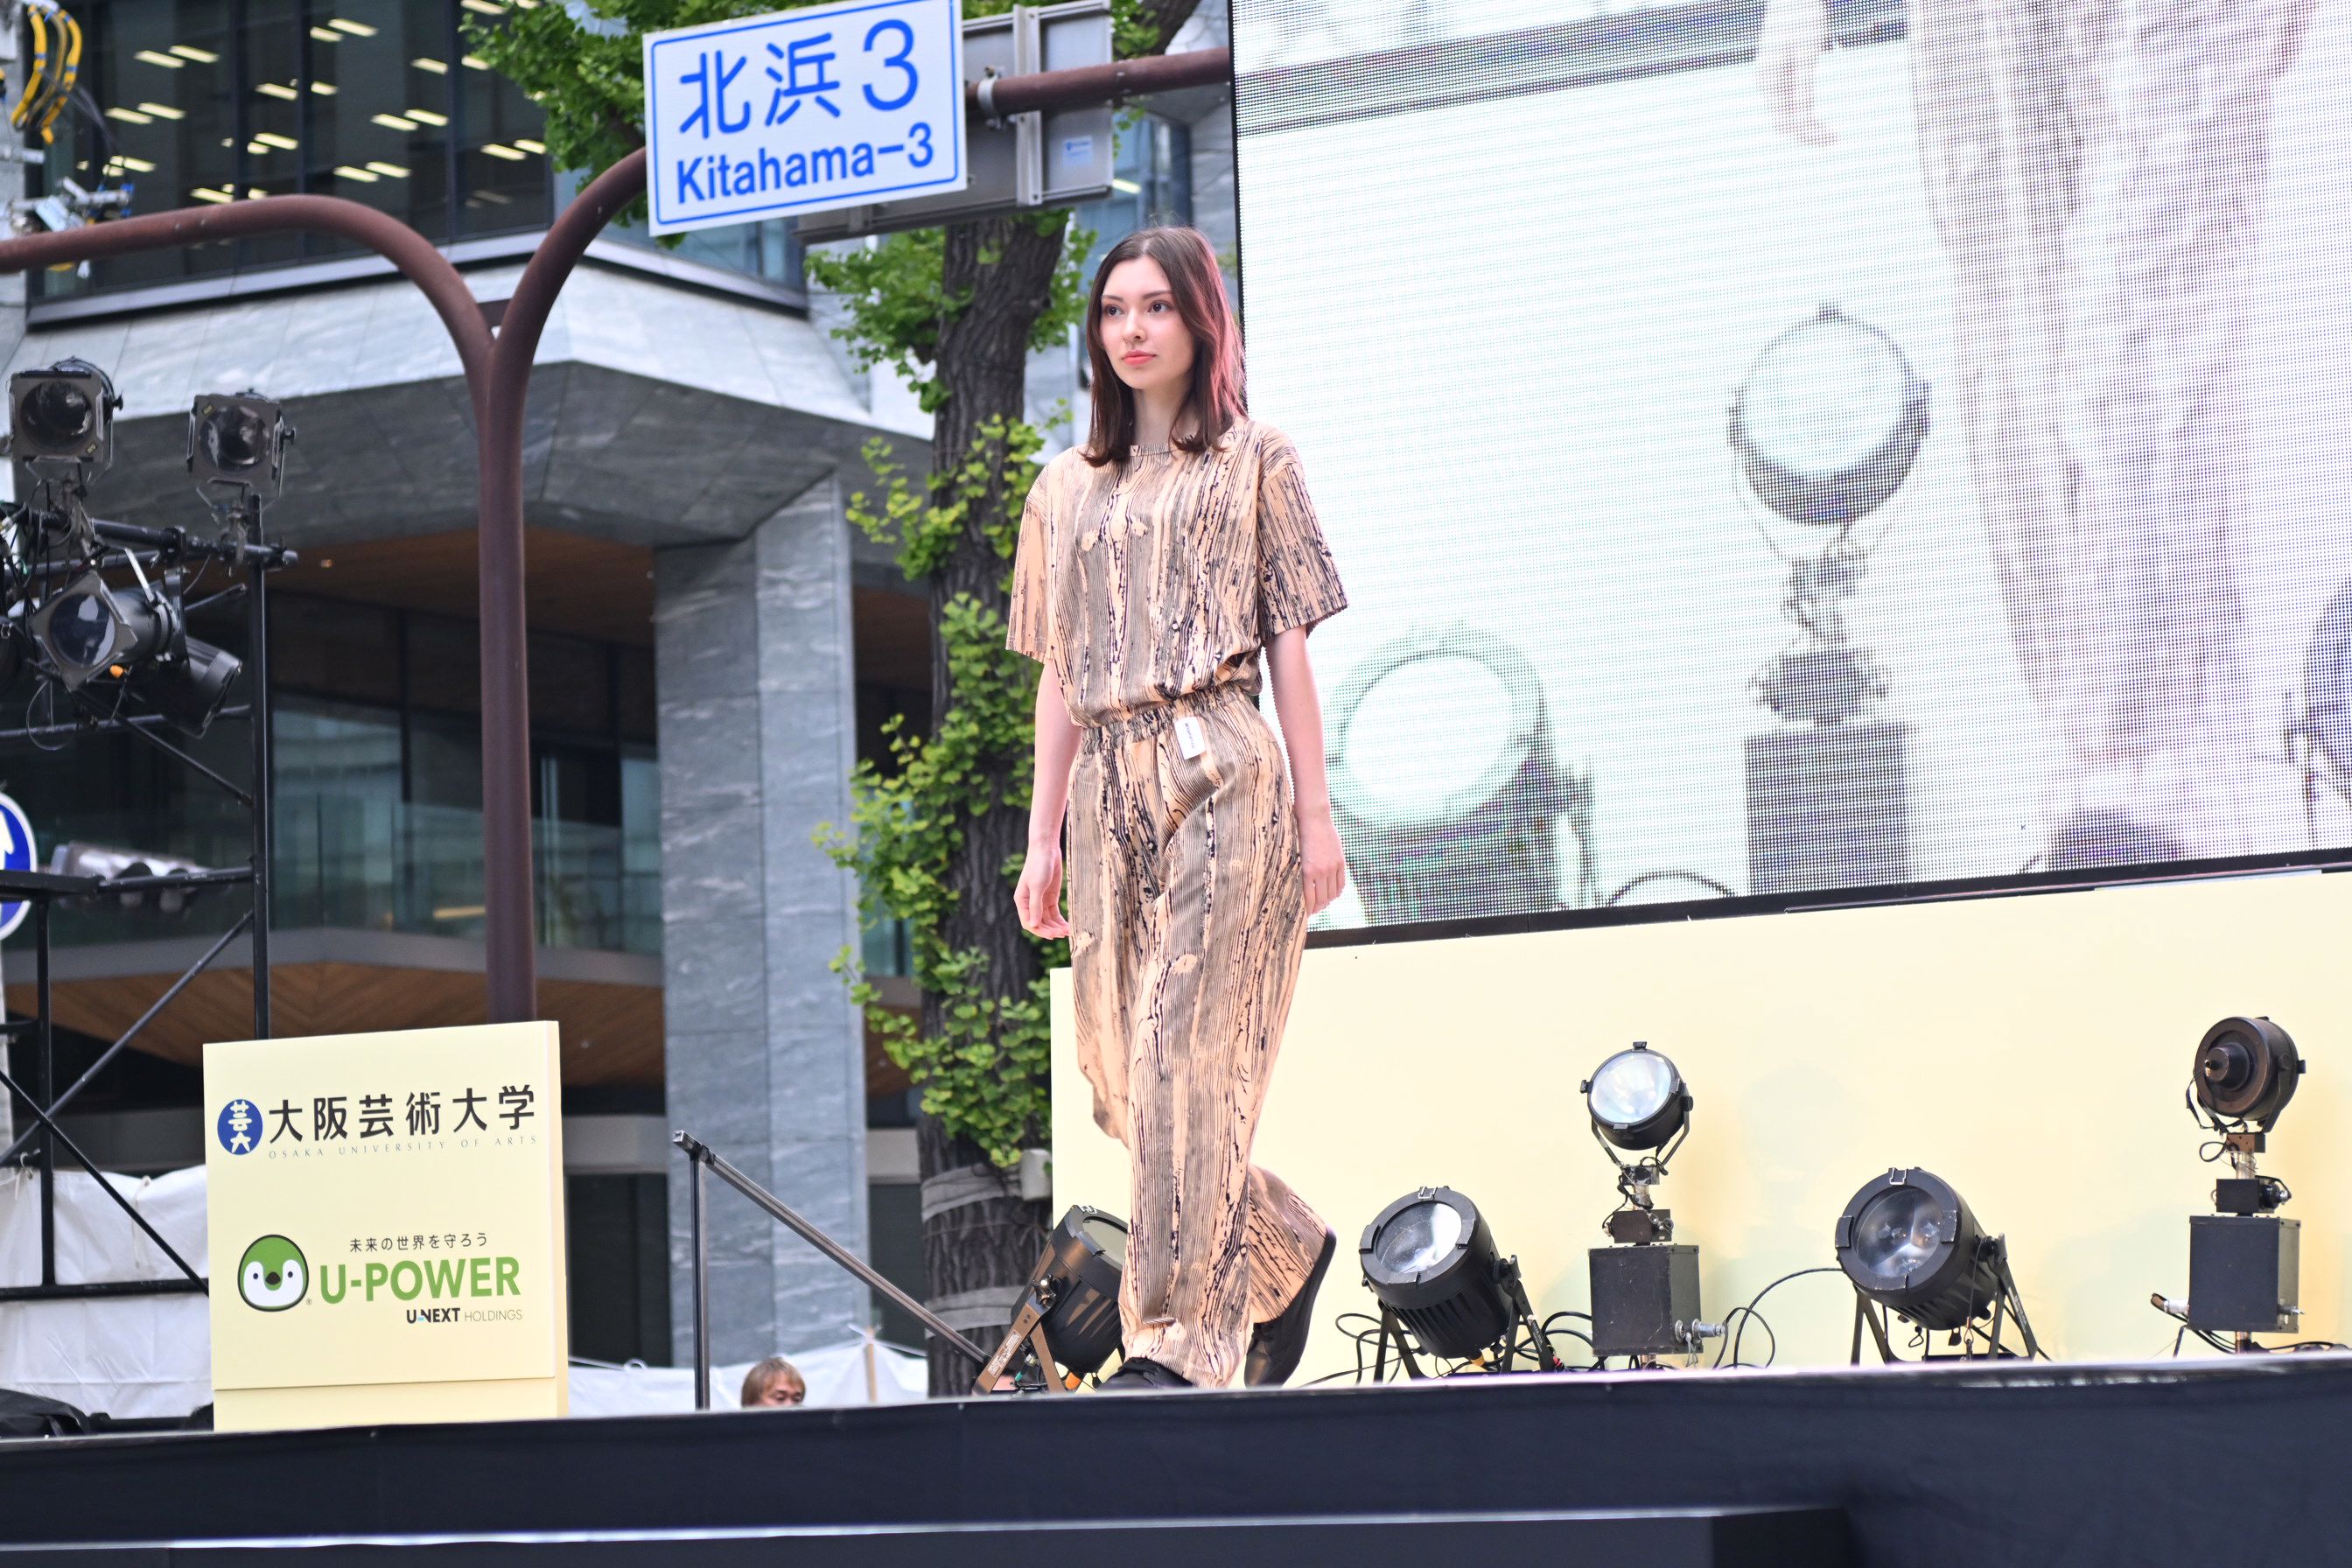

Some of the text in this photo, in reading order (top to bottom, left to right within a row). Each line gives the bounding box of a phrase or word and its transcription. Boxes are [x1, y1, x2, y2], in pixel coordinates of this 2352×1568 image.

[676, 121, 934, 204] Kitahama-3
[269, 1084, 535, 1144] 大阪芸術大学
[269, 1136, 536, 1159] OSAKA UNIVERSITY OF ARTS
[349, 1232, 487, 1253] 未来の世界を守ろう
[319, 1256, 522, 1305] U-POWER
[464, 1309, 522, 1322] HOLDINGS
